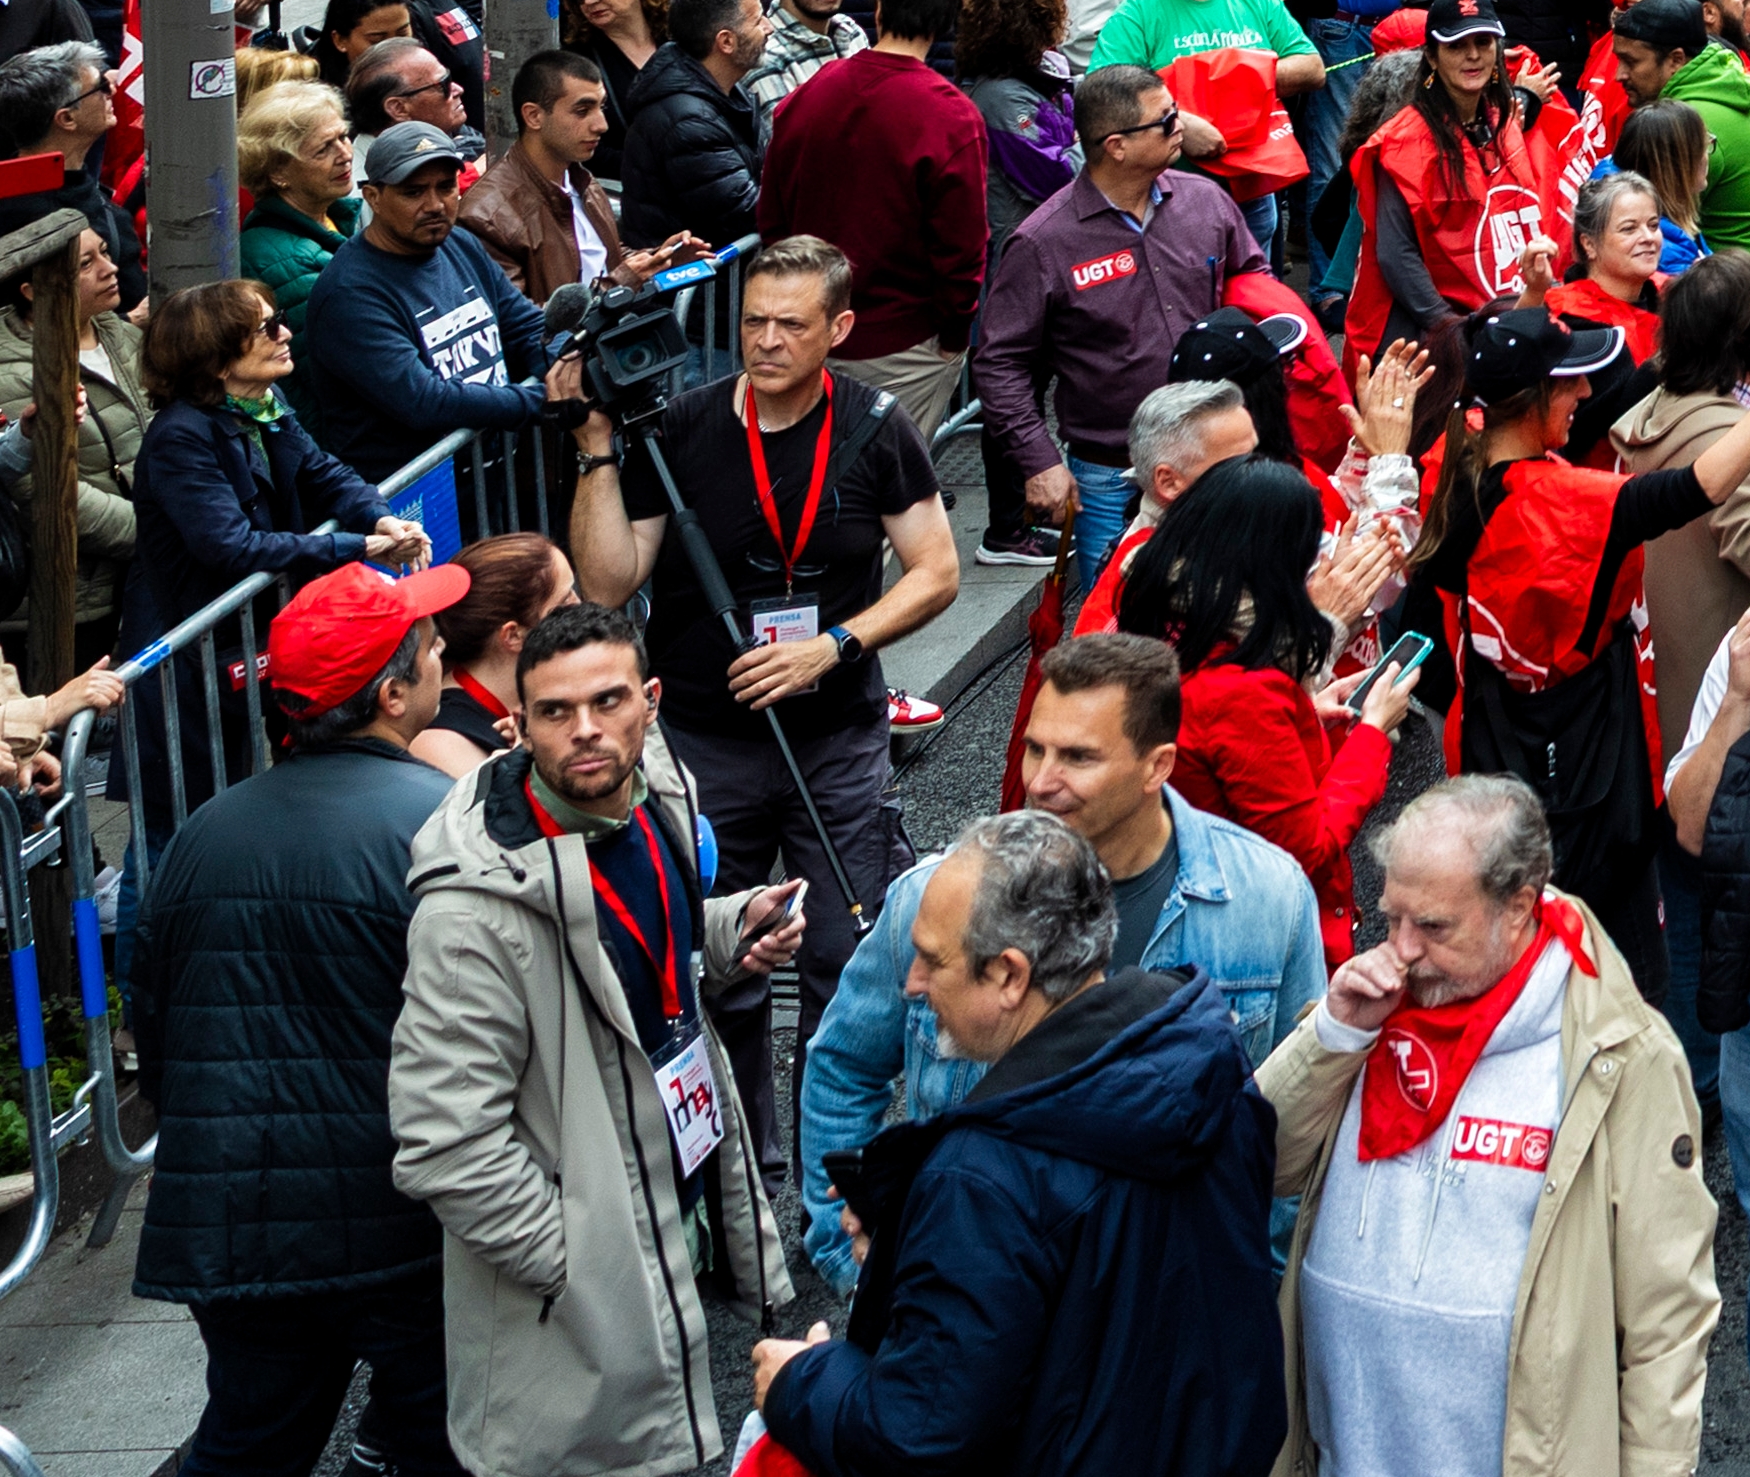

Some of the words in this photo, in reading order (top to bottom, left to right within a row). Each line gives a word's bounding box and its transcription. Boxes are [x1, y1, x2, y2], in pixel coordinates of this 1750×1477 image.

[1173, 31, 1220, 49] ESCUELA
[666, 266, 700, 282] tve
[1072, 259, 1116, 286] UGT
[768, 613, 802, 625] PRENSA
[668, 1050, 697, 1077] PRENSA
[1454, 1124, 1521, 1158] UGT
